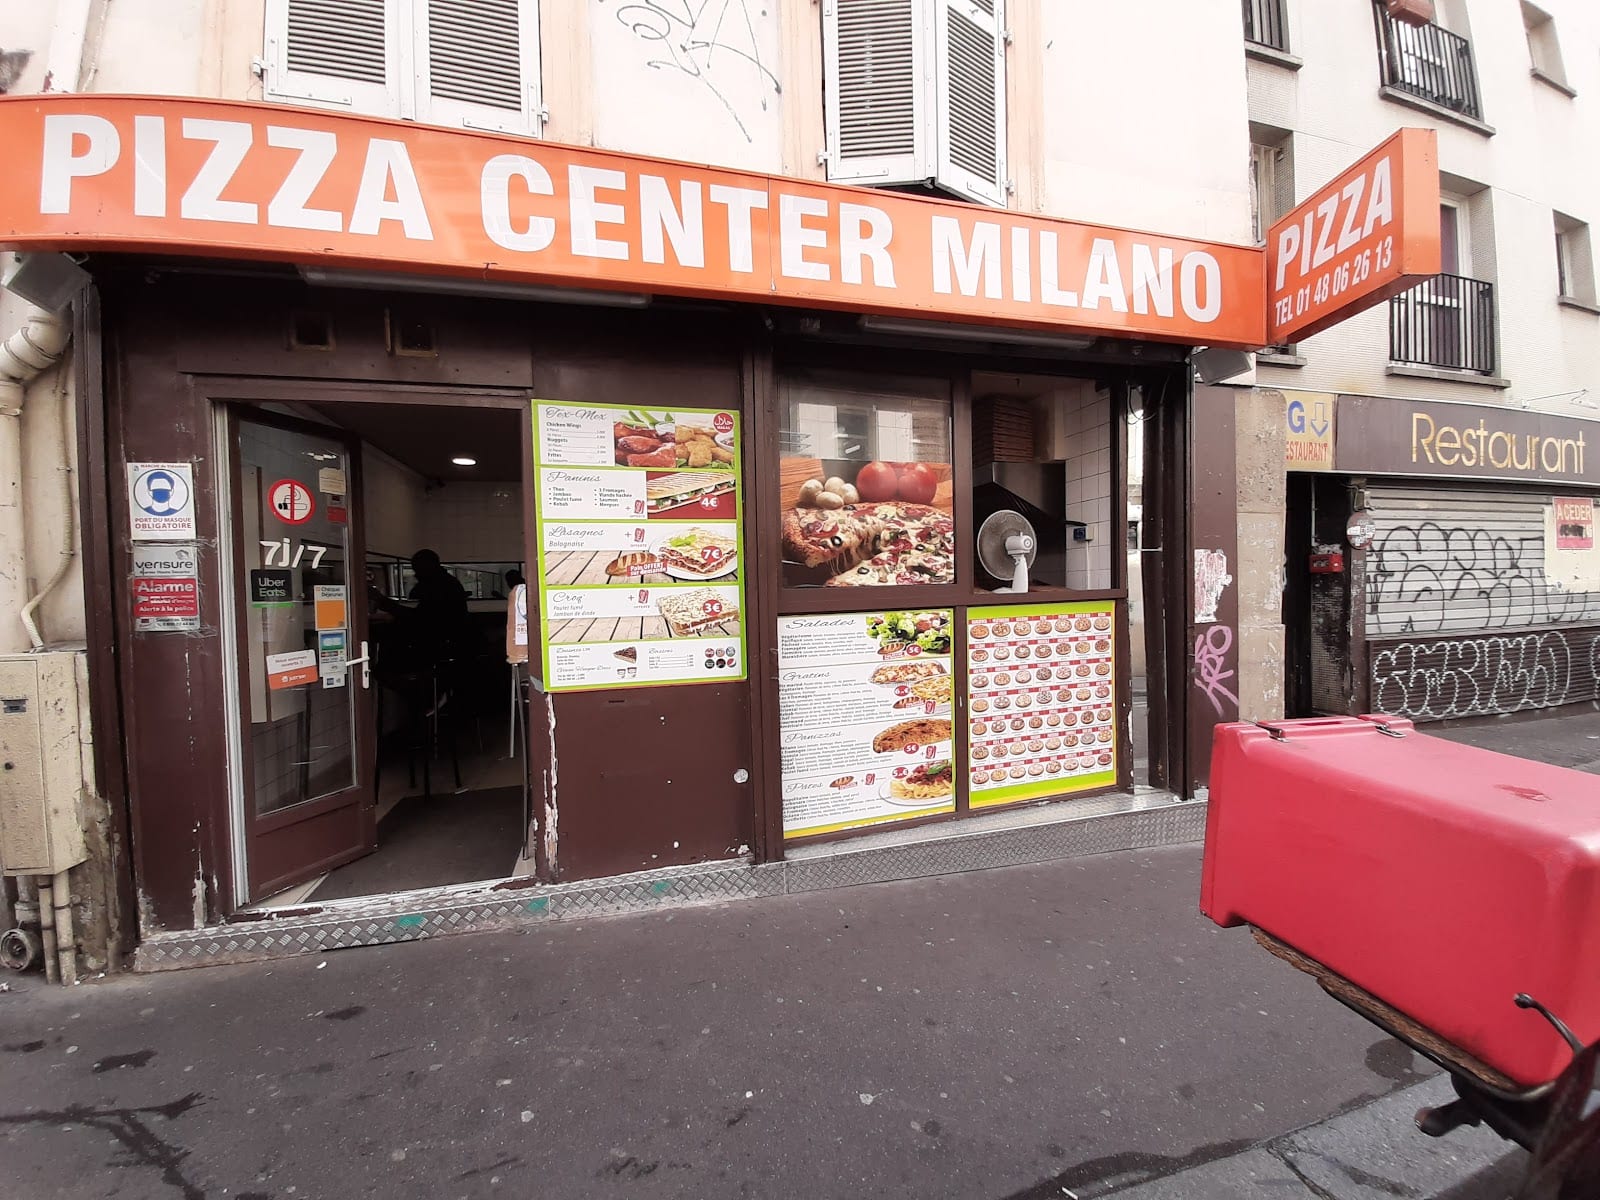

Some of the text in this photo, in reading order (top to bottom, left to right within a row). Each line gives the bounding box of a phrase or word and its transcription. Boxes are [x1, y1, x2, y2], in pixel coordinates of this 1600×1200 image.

[39, 113, 1223, 325] PIZZA CENTER MILANO
[1275, 156, 1393, 292] PIZZA
[1275, 235, 1393, 327] TEL 01 48 06 26 13
[545, 406, 608, 421] Tex-Mex
[1287, 400, 1306, 434] G
[1411, 412, 1587, 475] Restaurant
[547, 471, 602, 482] Paninis
[701, 498, 718, 508] 4€
[1564, 503, 1592, 521] CEDER
[548, 525, 606, 539] Lasagnes
[259, 537, 328, 570] 7j/7
[703, 549, 721, 560] 7€
[135, 560, 194, 569] verisure
[643, 561, 663, 571] OFFERT
[137, 581, 195, 593] Alarme
[258, 577, 286, 587] Uber
[258, 587, 287, 597] Eats
[704, 603, 721, 613] 3€
[785, 618, 857, 630] Salades
[782, 671, 832, 682] Gratins
